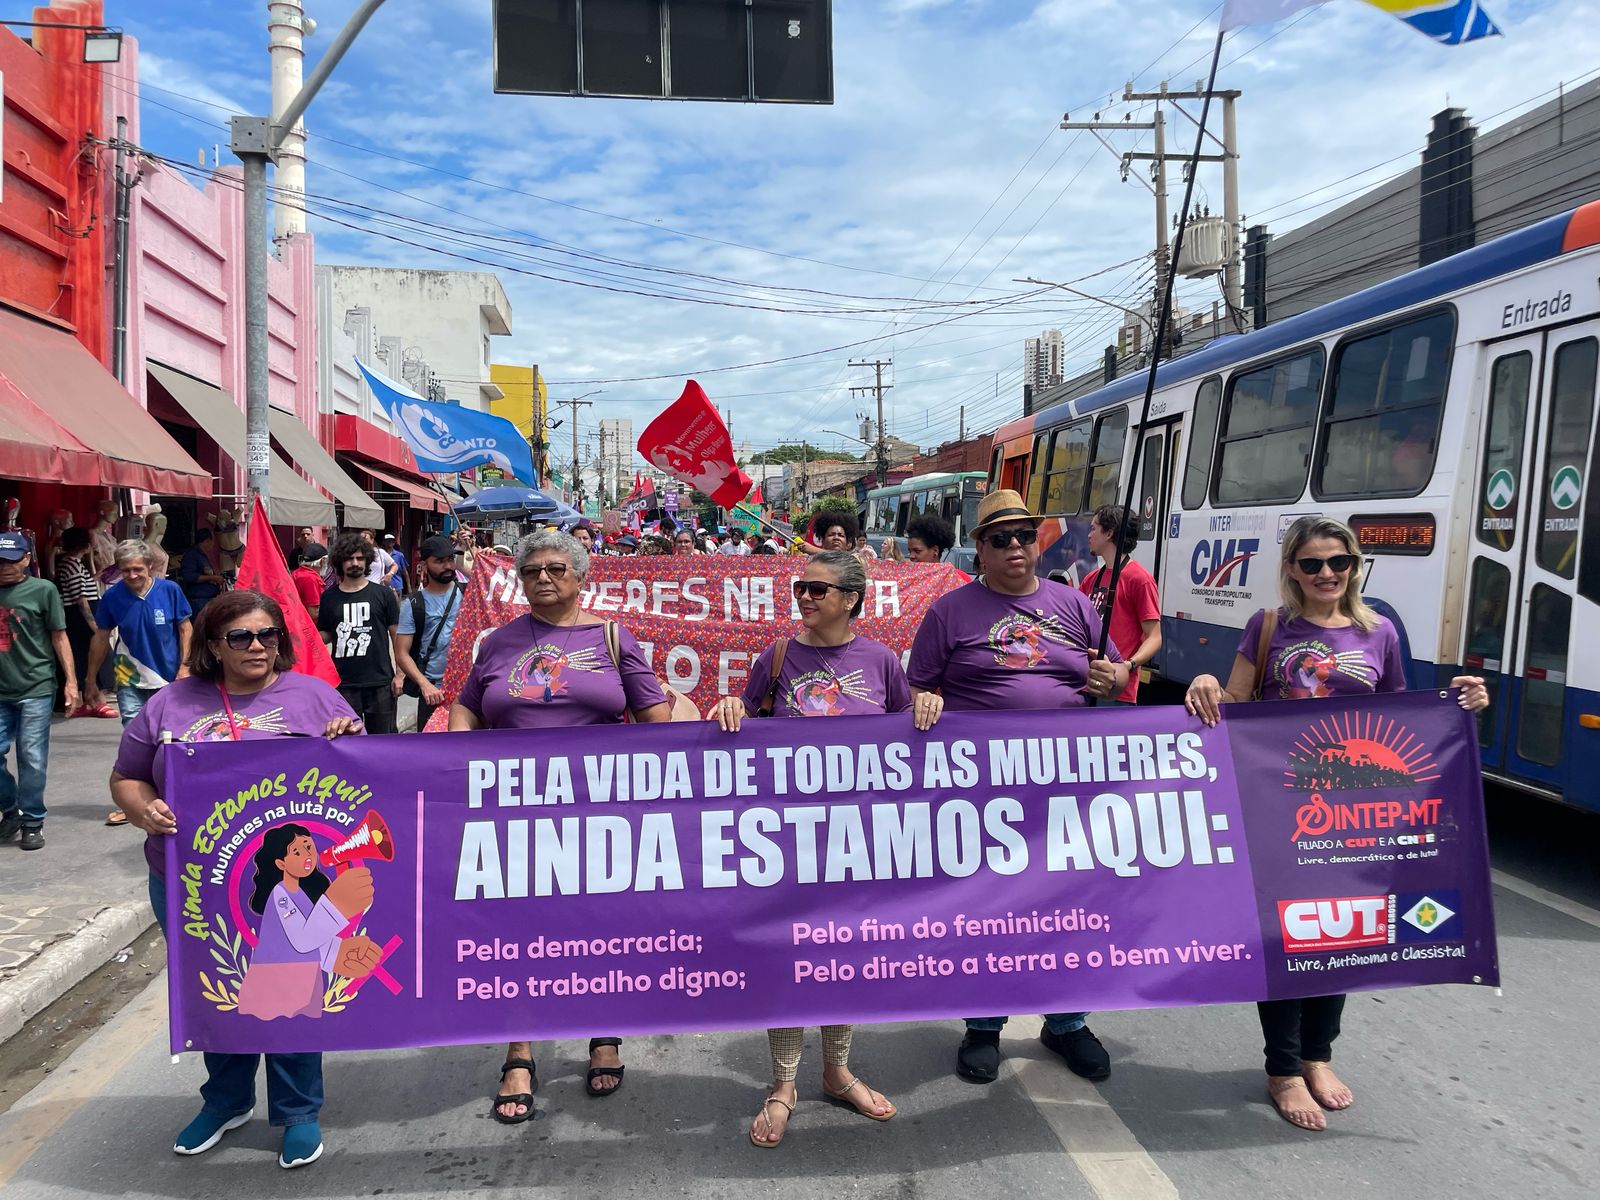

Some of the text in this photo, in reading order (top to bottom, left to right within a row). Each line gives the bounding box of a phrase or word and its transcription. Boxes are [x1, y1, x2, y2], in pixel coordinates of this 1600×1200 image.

[1501, 290, 1571, 329] Entrada
[1482, 518, 1514, 530] ENTRADA
[1190, 538, 1260, 587] CMT
[724, 576, 774, 622] NA
[1204, 598, 1235, 607] TRANSPORTES
[1214, 589, 1252, 600] METROPOLITANO
[343, 602, 371, 627] UP
[468, 732, 1218, 809] PELA VIDA DE TODAS AS MULHERES,
[1290, 793, 1443, 843] SINTEP-MT
[180, 767, 373, 941] Ainda Estamos Aqui!
[210, 800, 354, 885] Mulheres na luta por
[454, 790, 1235, 900] AINDA ESTAMOS AQUI:
[1297, 833, 1435, 851] FILIADO A CUT E A CNTE
[1329, 853, 1395, 864] democrático
[1405, 851, 1418, 859] de
[1420, 848, 1439, 857] luta!
[792, 907, 1112, 945] Pelo fim do feminicídio;
[1284, 898, 1385, 941] CUT
[1387, 894, 1397, 944] MATO GROSSO
[457, 928, 704, 962] Pela democracia;
[794, 939, 1252, 983] Pelo direito a terra e o bem viver.
[1286, 945, 1466, 972] Livre, Autônoma e Classista!
[457, 965, 747, 1000] Pelo trabalho digno;
